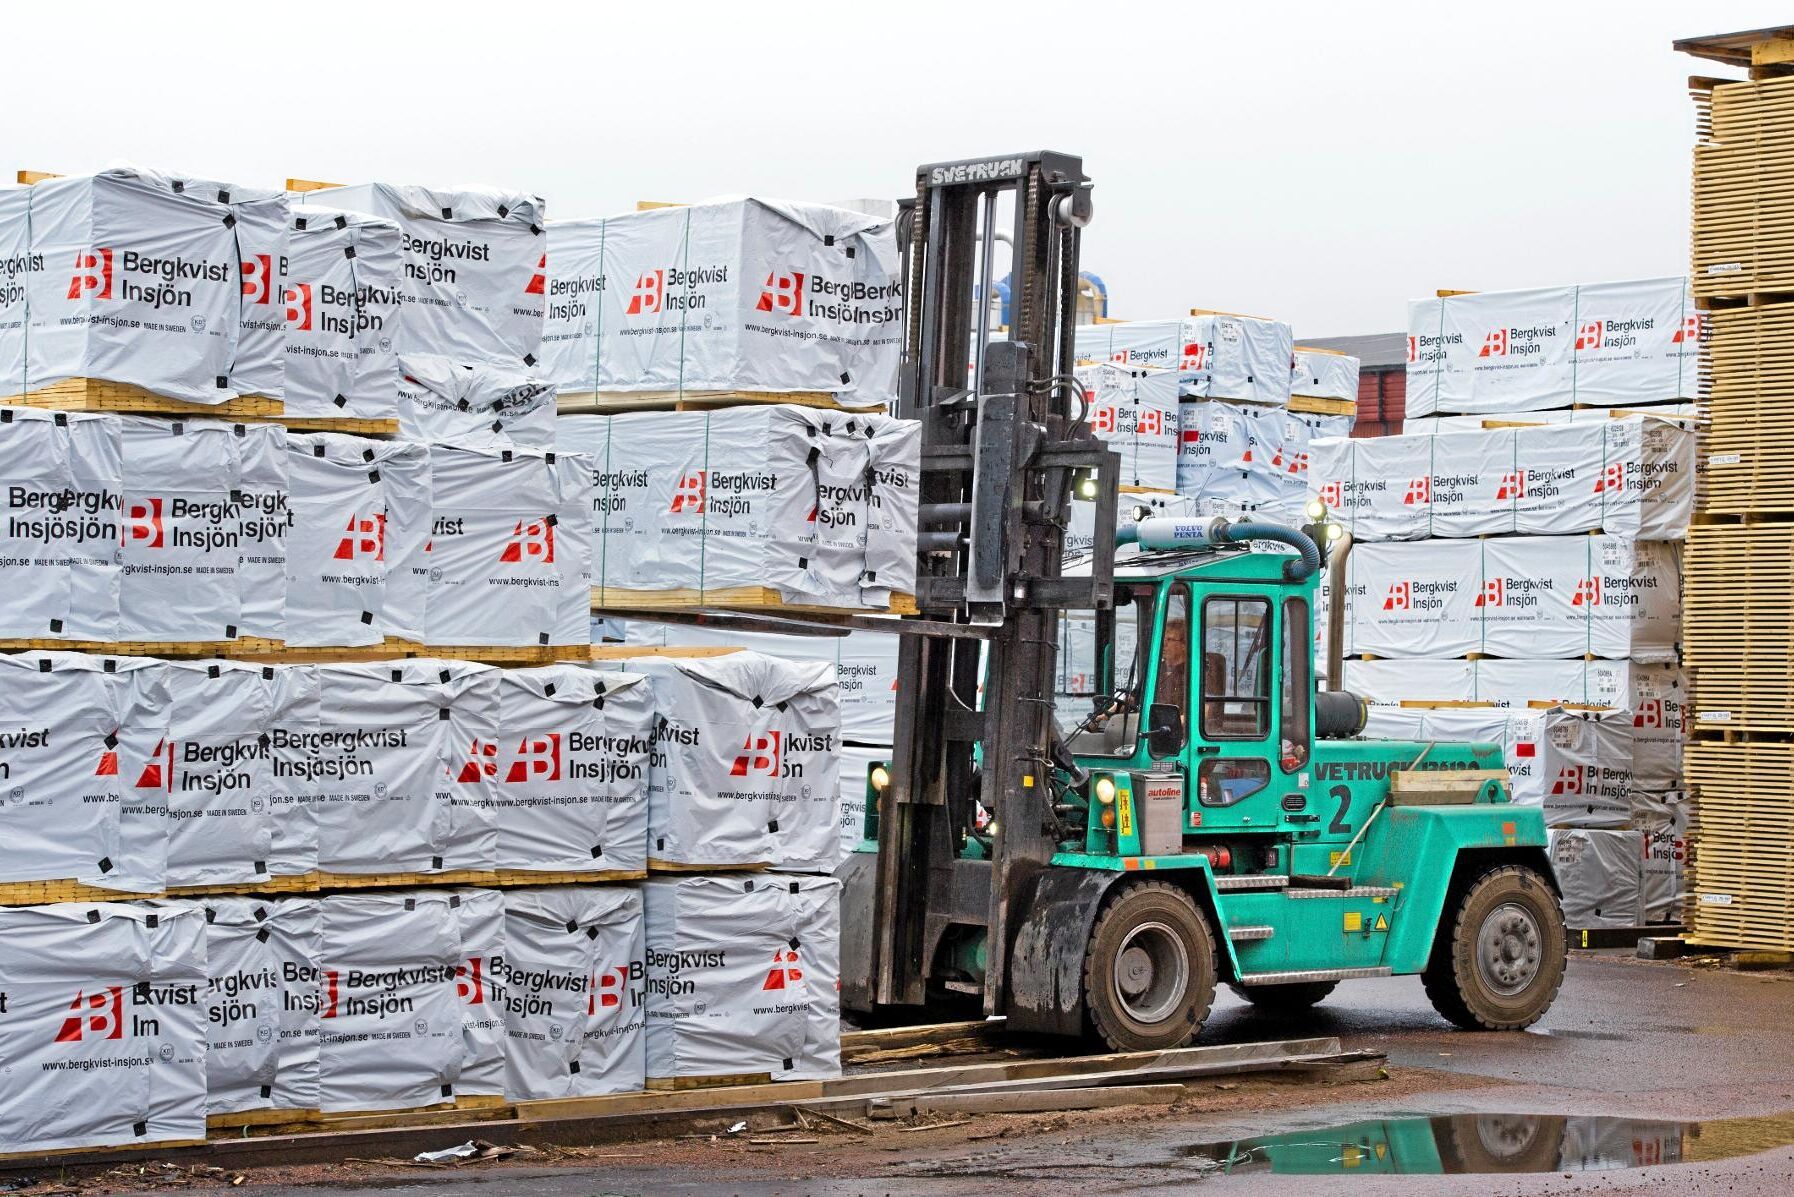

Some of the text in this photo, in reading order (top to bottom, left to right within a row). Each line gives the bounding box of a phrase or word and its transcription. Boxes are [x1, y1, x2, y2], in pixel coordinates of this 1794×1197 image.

[401, 233, 490, 262] Bergkvist
[122, 250, 229, 283] Bergkvist
[667, 264, 728, 288] Bergkvist
[549, 273, 606, 297] Bergkvist
[122, 279, 192, 309] Insjön
[665, 290, 706, 315] Insjön
[548, 300, 587, 322] Insjön
[1510, 325, 1556, 342] Bergkvist
[1605, 317, 1655, 335] Bergkvist
[1419, 332, 1463, 348] Bergkvist
[1604, 334, 1637, 350] Insjön
[1130, 349, 1168, 362] Bergkvist
[1419, 348, 1448, 363] Insjön
[1509, 341, 1541, 357] Insjön
[1527, 467, 1576, 483] Bergkvist
[1626, 460, 1678, 477] Bergkvist
[592, 469, 648, 491] Bergkvist
[711, 470, 778, 493] Bergkvist
[1433, 473, 1479, 489] Bergkvist
[1626, 476, 1662, 493] Insjön
[1433, 490, 1464, 506] Insjön
[1527, 484, 1560, 499] Insjön
[709, 494, 751, 518] Insjön
[1343, 494, 1372, 508] Insjön
[172, 526, 238, 553] Insjön
[1412, 580, 1458, 596] Bergkvist
[1505, 577, 1553, 594] Bergkvist
[1604, 575, 1658, 591] Bergkvist
[1412, 596, 1444, 612] Insjön
[1505, 593, 1538, 610] Insjön
[1603, 592, 1639, 607] Insjön
[838, 664, 877, 678] Bergkvist
[182, 770, 251, 796] Insjön
[350, 793, 371, 803] SWEDEN
[1148, 788, 1181, 797] autoline
[1328, 784, 1351, 834] 2
[646, 948, 726, 971] Bergkvist
[347, 966, 446, 992] Bergkvist
[504, 964, 588, 994] Bergkvist
[646, 974, 696, 999] Insjön
[346, 997, 414, 1020] Insjön
[233, 1039, 254, 1049] SWEDEN
[392, 1031, 412, 1041] SWEDEN
